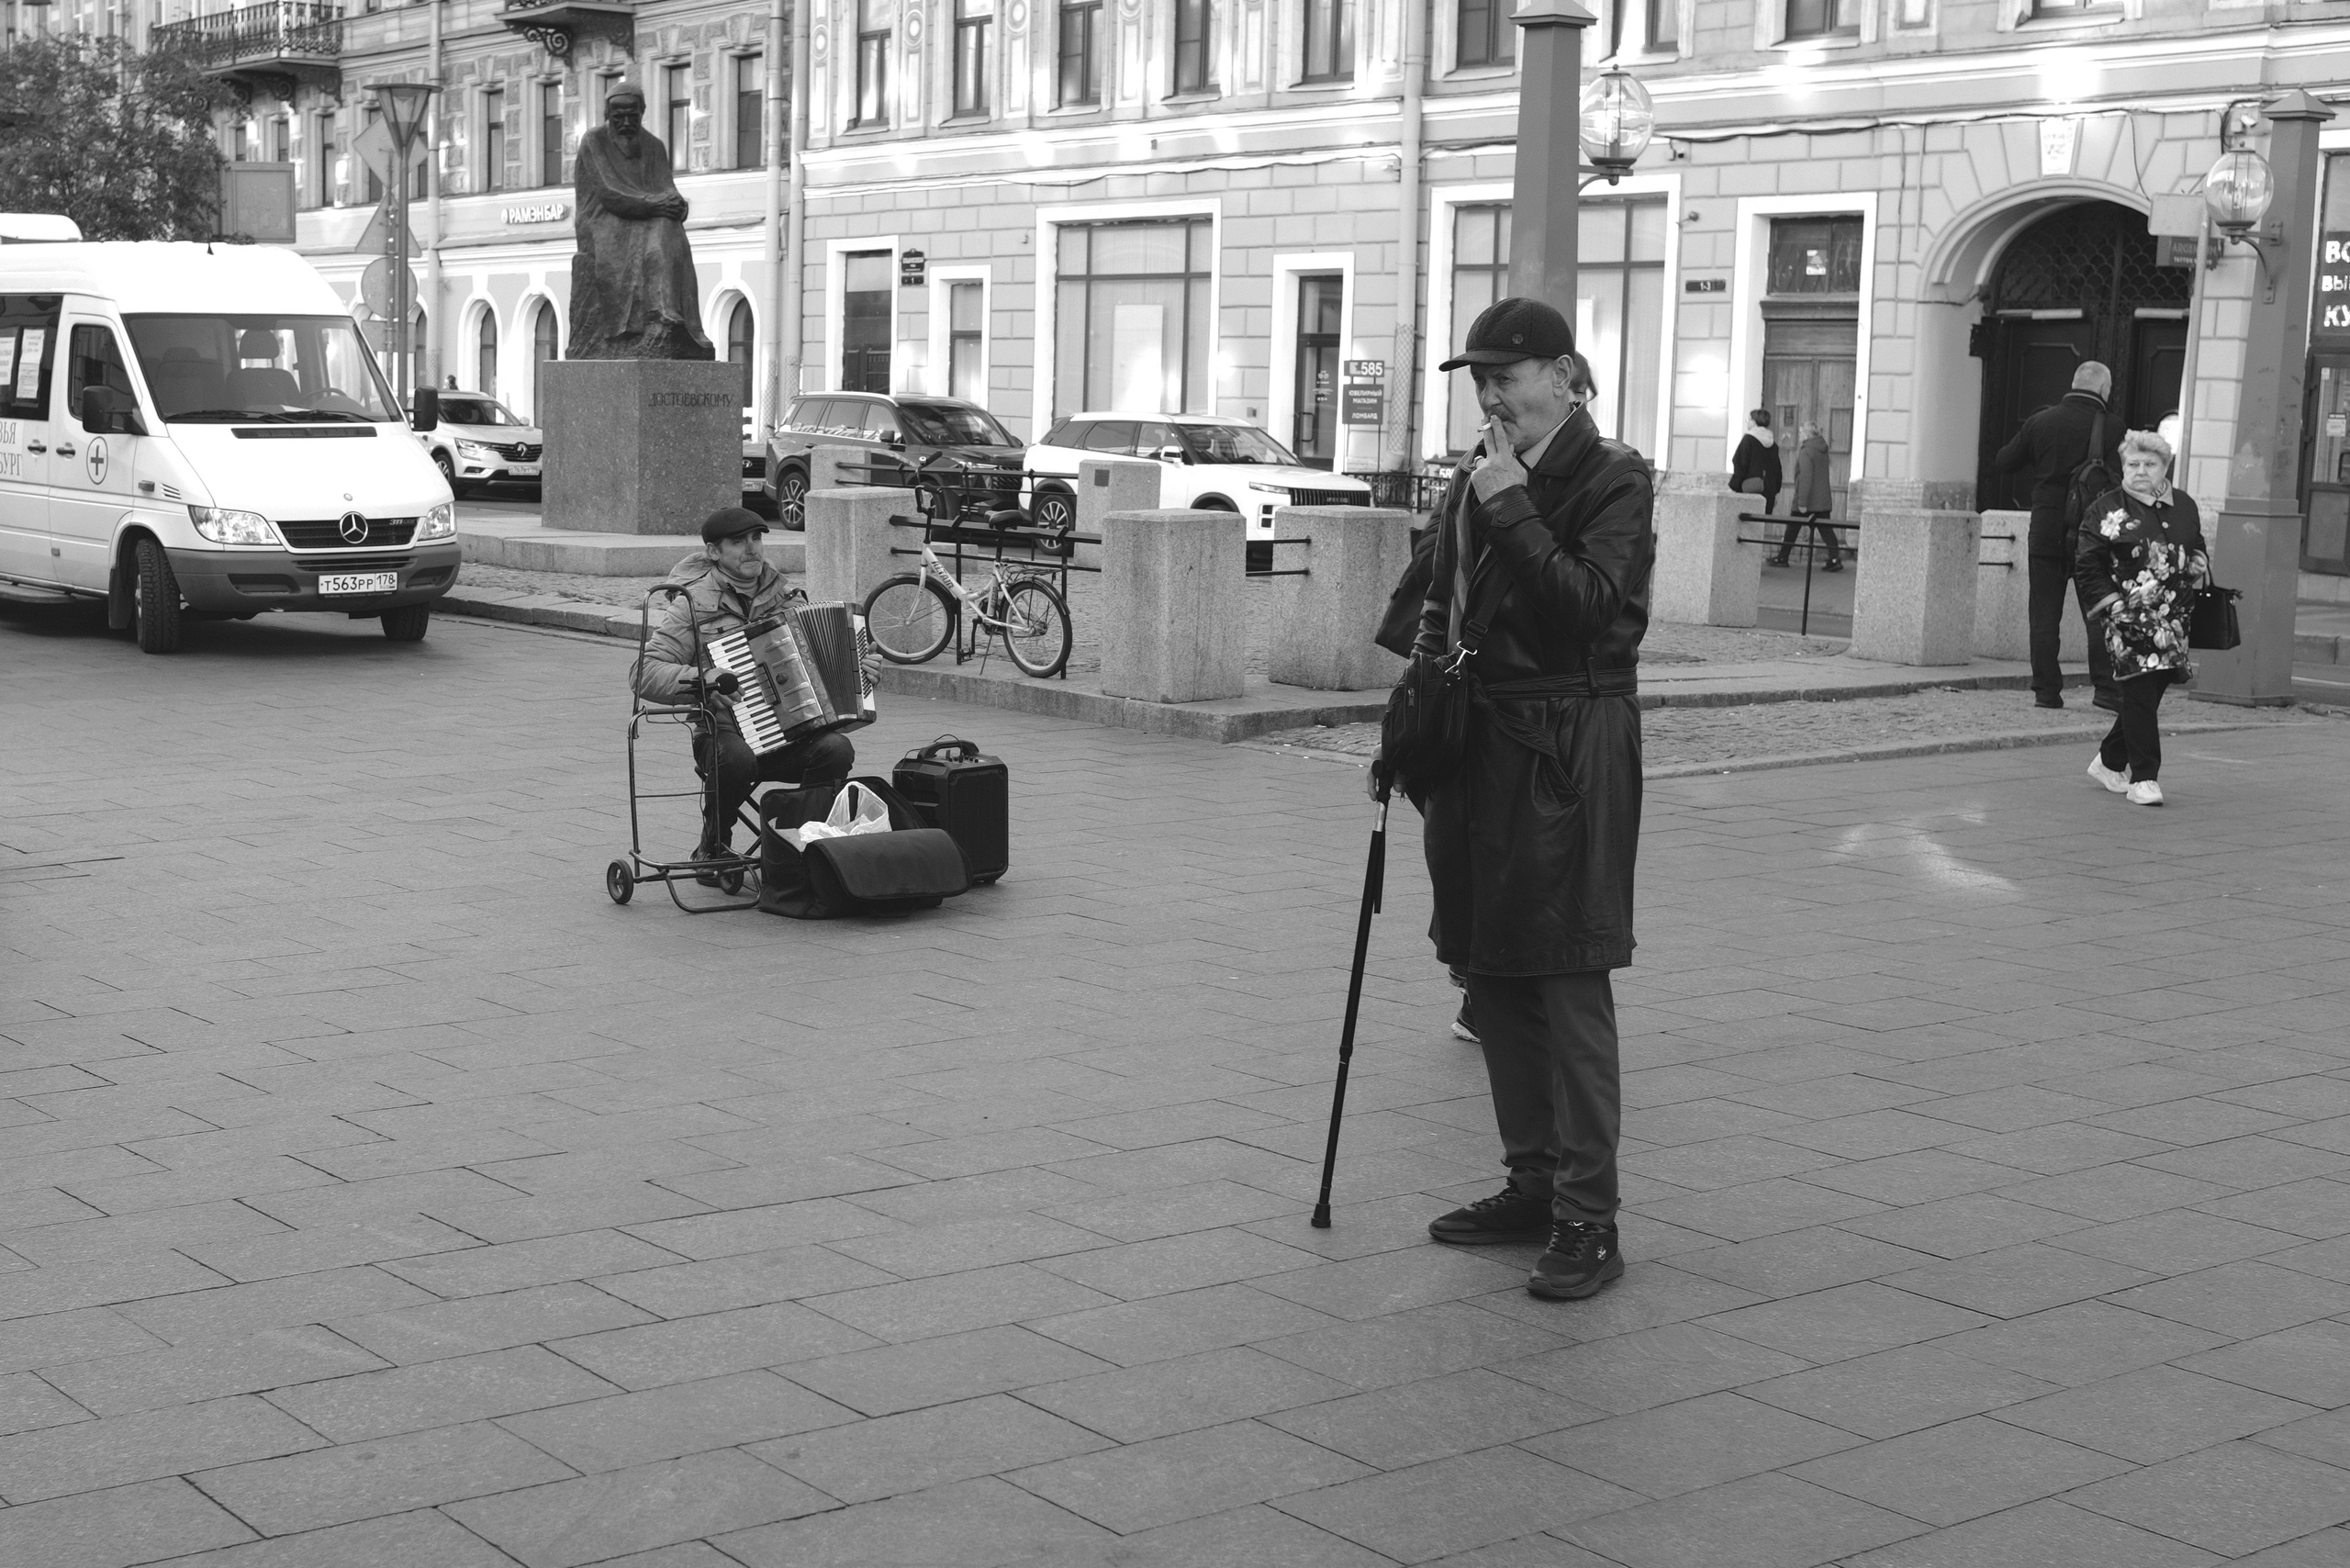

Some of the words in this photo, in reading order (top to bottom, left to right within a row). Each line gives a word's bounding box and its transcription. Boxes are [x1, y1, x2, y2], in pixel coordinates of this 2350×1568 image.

[509, 203, 564, 224] РАМЭНБАР
[2322, 275, 2350, 291] ВЫ
[1360, 361, 1383, 375] 585
[648, 392, 734, 407] ДОСТОЕВСКОМУ
[324, 577, 374, 591] Т563РР
[376, 574, 394, 586] 178
